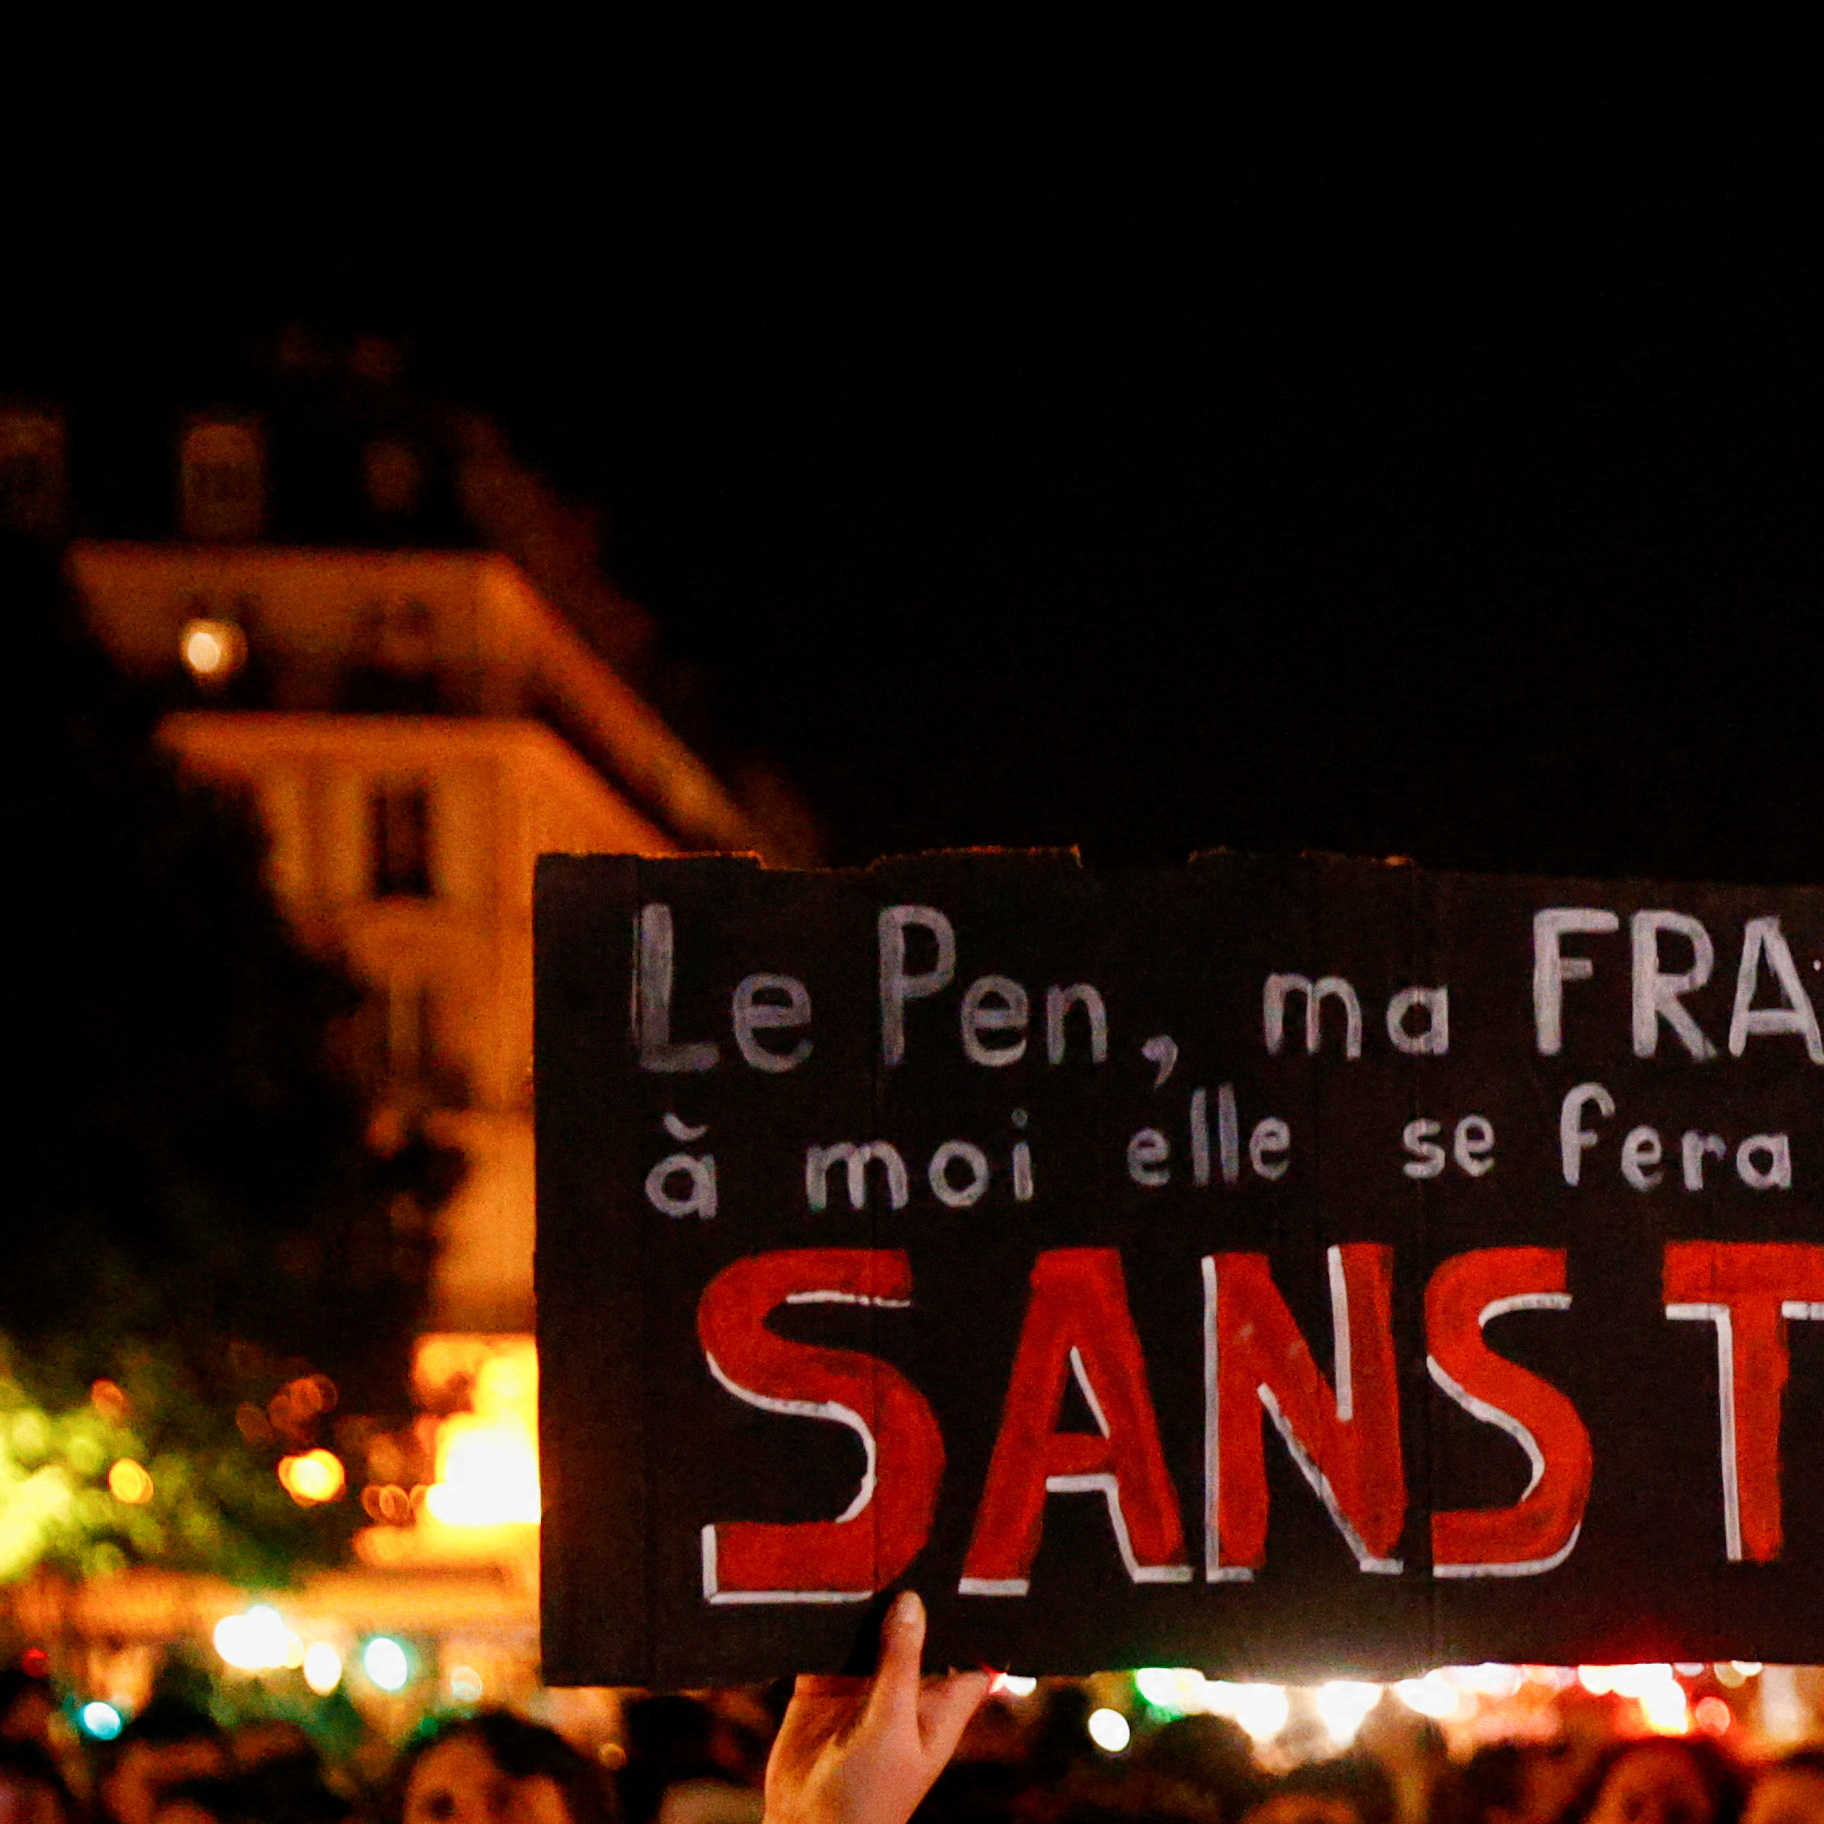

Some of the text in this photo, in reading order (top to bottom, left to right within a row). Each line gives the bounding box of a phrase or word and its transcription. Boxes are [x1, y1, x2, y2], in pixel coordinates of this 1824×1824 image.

[630, 902, 814, 1073] Le
[877, 903, 1180, 1090] Pen,
[1262, 970, 1450, 1061] ma
[644, 1080, 1793, 1221] à moi elle se fera
[696, 1241, 1595, 1606] SANS
